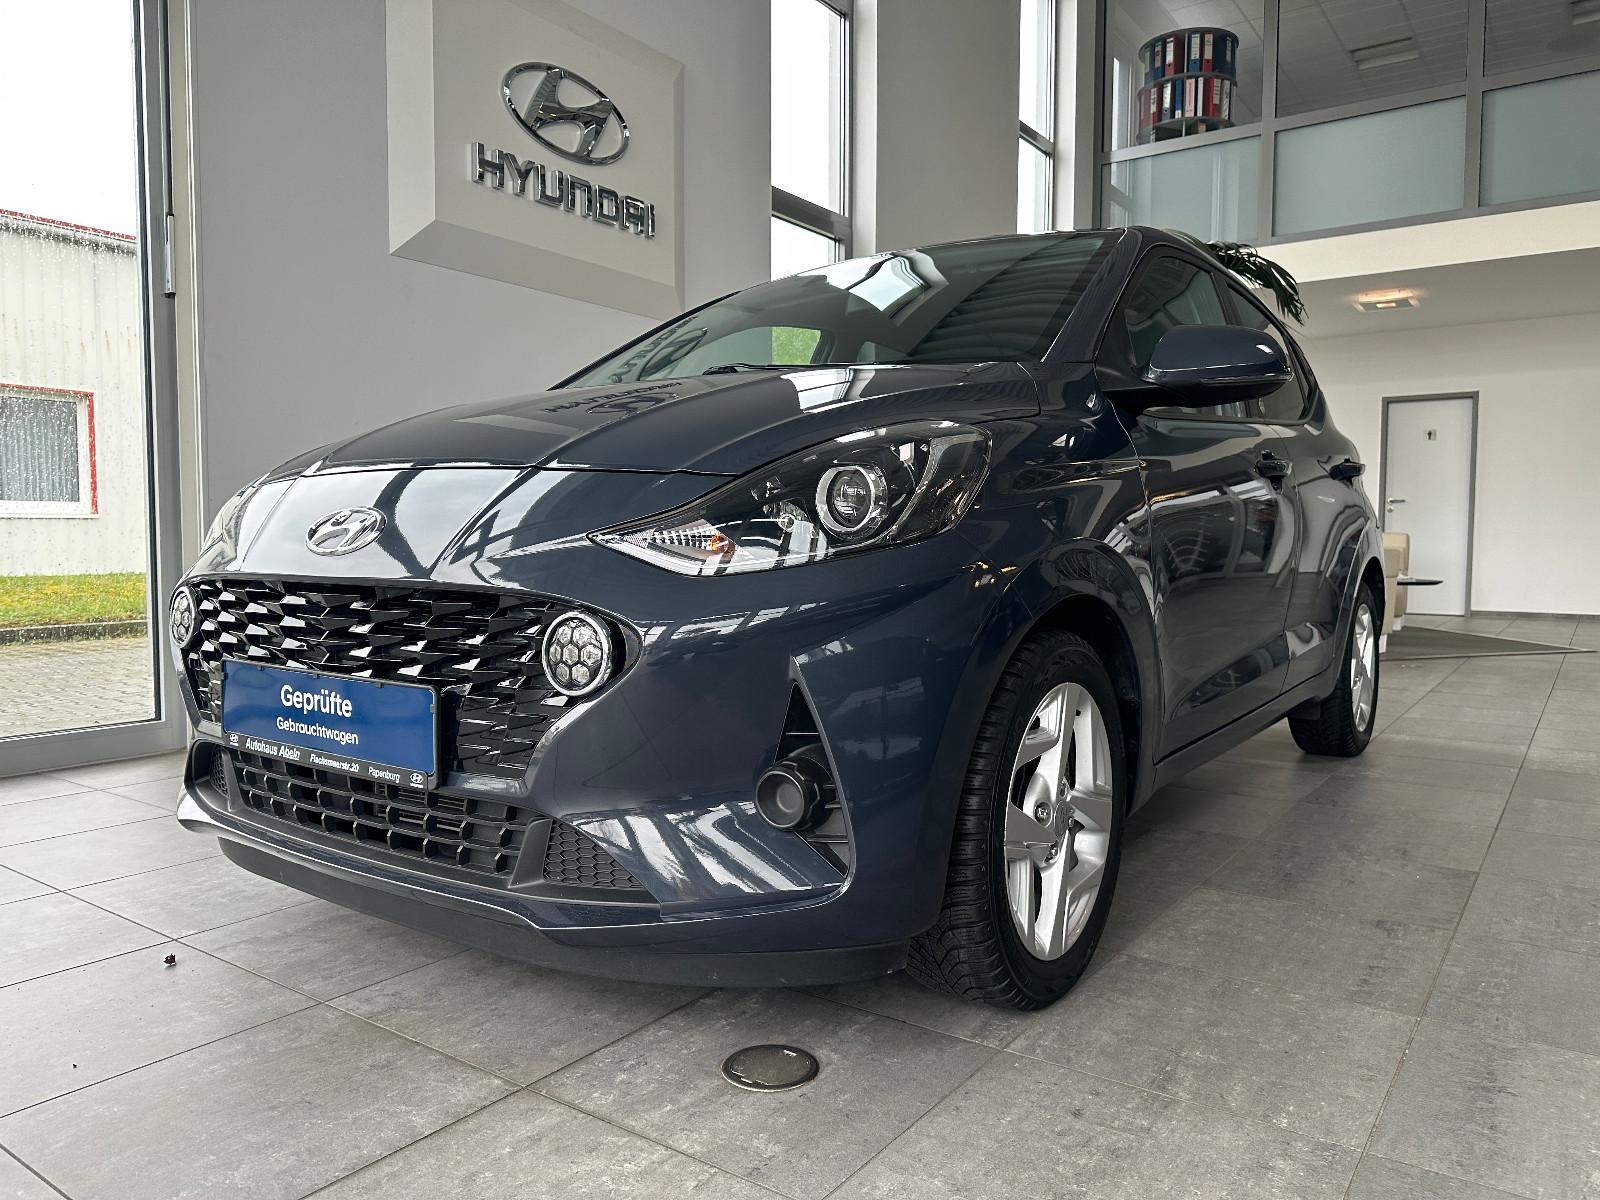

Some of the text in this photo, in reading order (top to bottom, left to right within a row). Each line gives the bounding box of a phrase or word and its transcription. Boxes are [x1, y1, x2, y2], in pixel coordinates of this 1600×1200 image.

[470, 142, 656, 238] HYUNDAI
[280, 684, 353, 718] Geprüfte
[276, 716, 359, 745] Gebrauchtwagen
[245, 737, 278, 755] Autohaus
[367, 766, 401, 784] Papenburg
